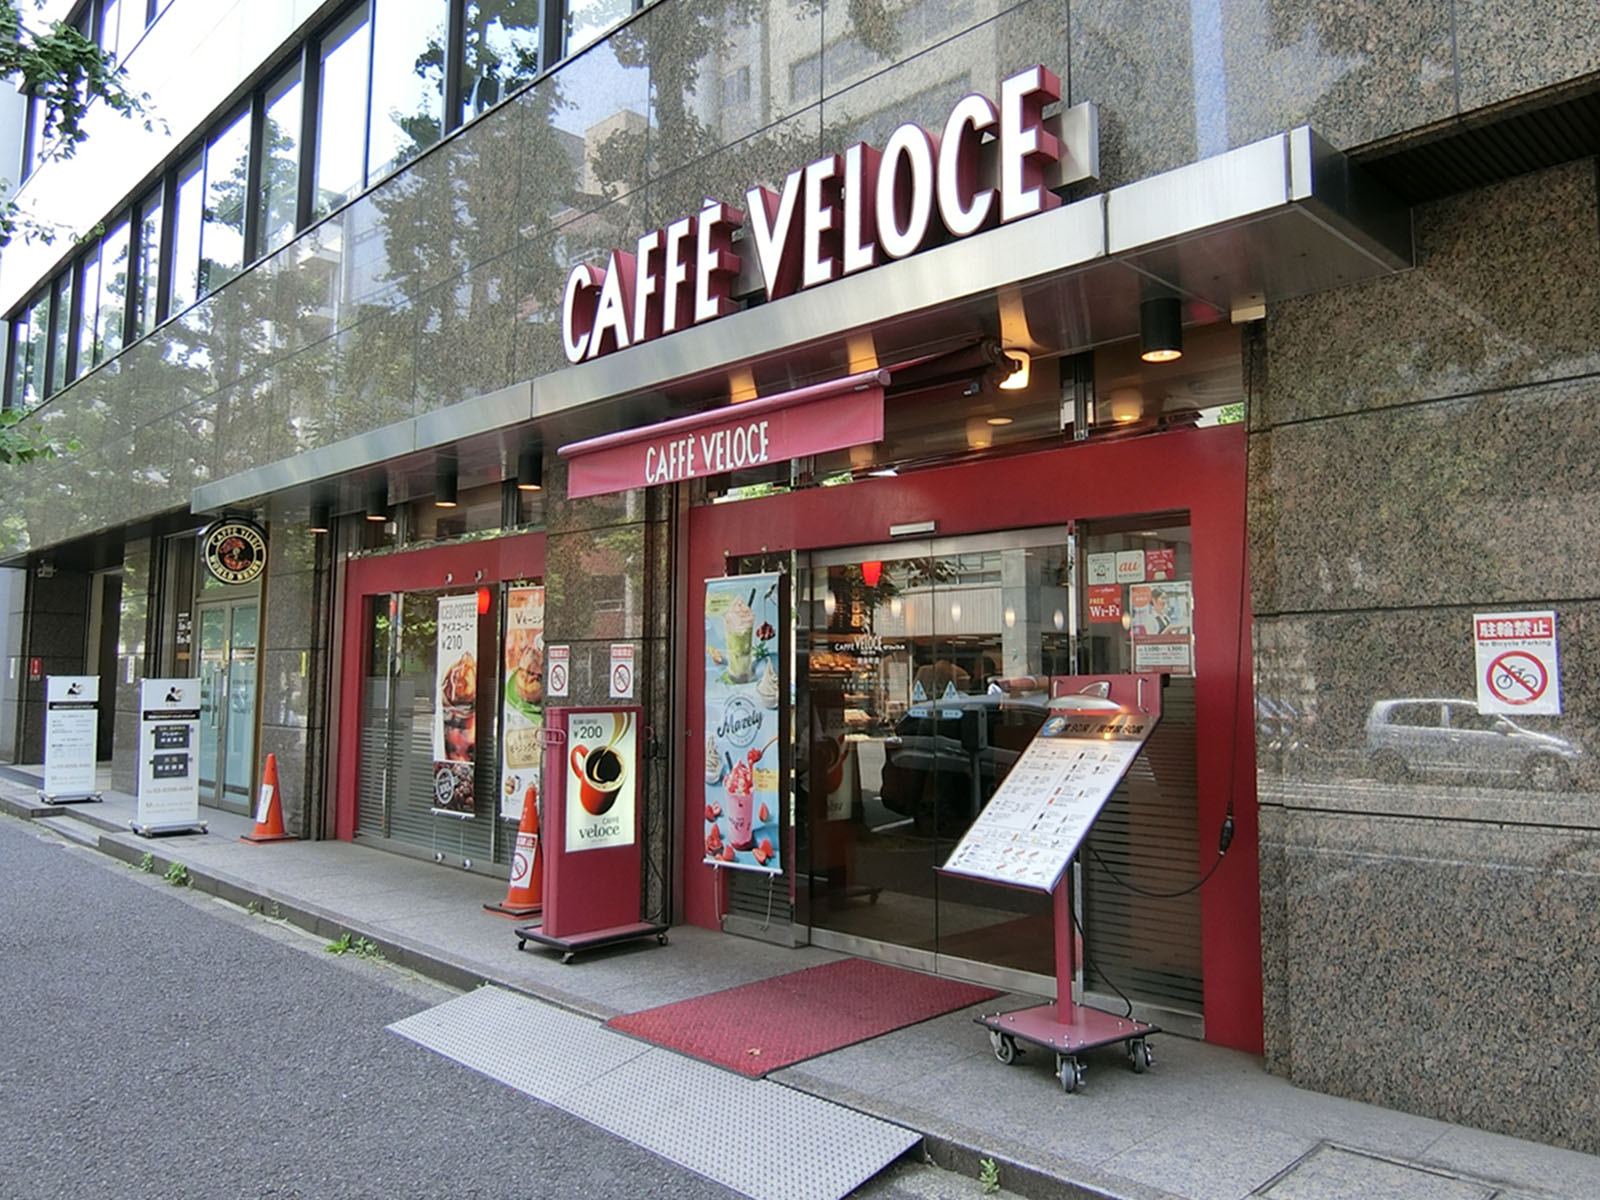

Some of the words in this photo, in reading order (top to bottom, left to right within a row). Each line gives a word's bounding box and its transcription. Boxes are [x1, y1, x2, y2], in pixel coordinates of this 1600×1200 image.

[561, 197, 730, 364] CAFFÈ
[746, 64, 1048, 301] VELOCE
[645, 433, 695, 484] CAFFÈ
[701, 421, 769, 470] VELOCE
[1119, 562, 1139, 573] au
[1089, 604, 1121, 617] Wi-Fi
[441, 621, 475, 633] アイスコーヒー
[1479, 619, 1550, 638] 駐輪禁止
[574, 725, 603, 739] ¥200
[579, 823, 621, 839] veloce
